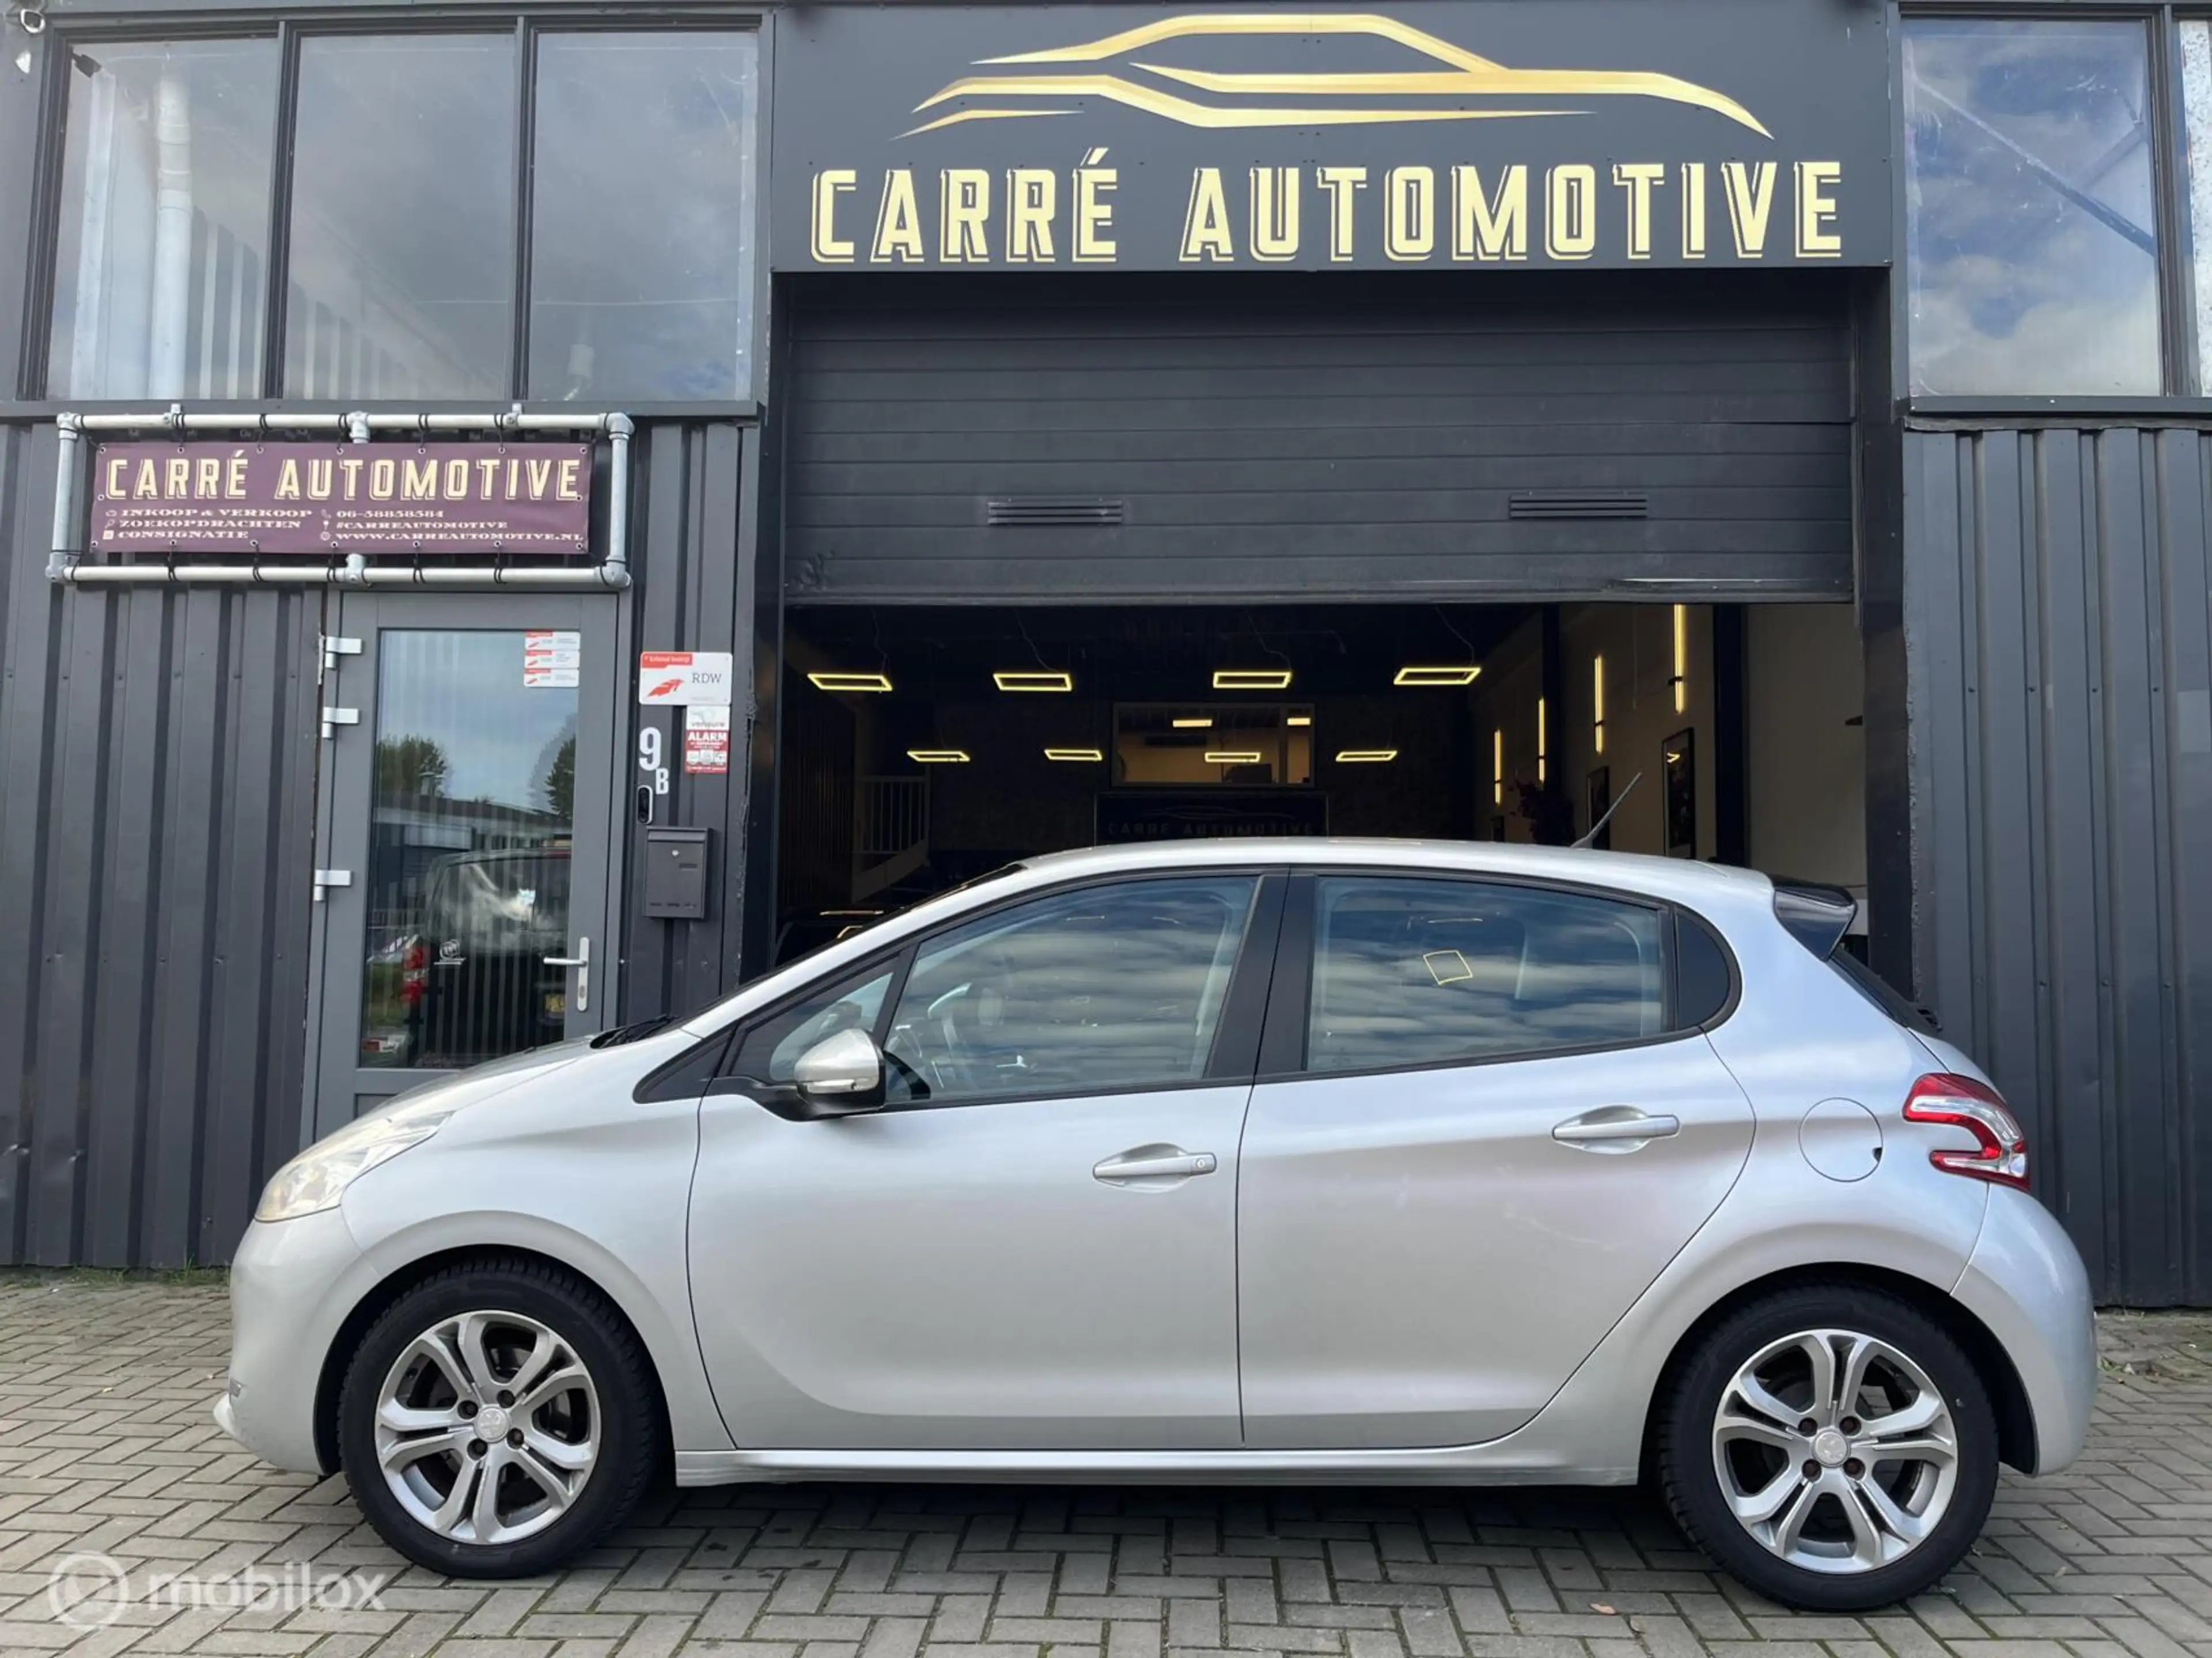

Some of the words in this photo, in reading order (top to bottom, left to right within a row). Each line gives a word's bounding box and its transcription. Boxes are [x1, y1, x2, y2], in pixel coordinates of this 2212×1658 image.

[810, 147, 1118, 263] CARRÉ
[1179, 160, 1842, 263] AUTOMOTIVE
[106, 450, 248, 499] CARRÉ
[274, 459, 580, 501] AUTOMOTIVE
[122, 509, 198, 517] INKOOP
[218, 509, 312, 518] VERKOOP
[119, 519, 301, 529] ZOEKOPDRACHTEN
[118, 530, 249, 539] CONSIGNATIE
[335, 532, 584, 541] WWW.CARREAUTOMOTIVE.NL
[691, 673, 722, 684] RDW
[687, 732, 727, 742] ALARM
[639, 727, 662, 771] 9
[655, 768, 670, 795] B
